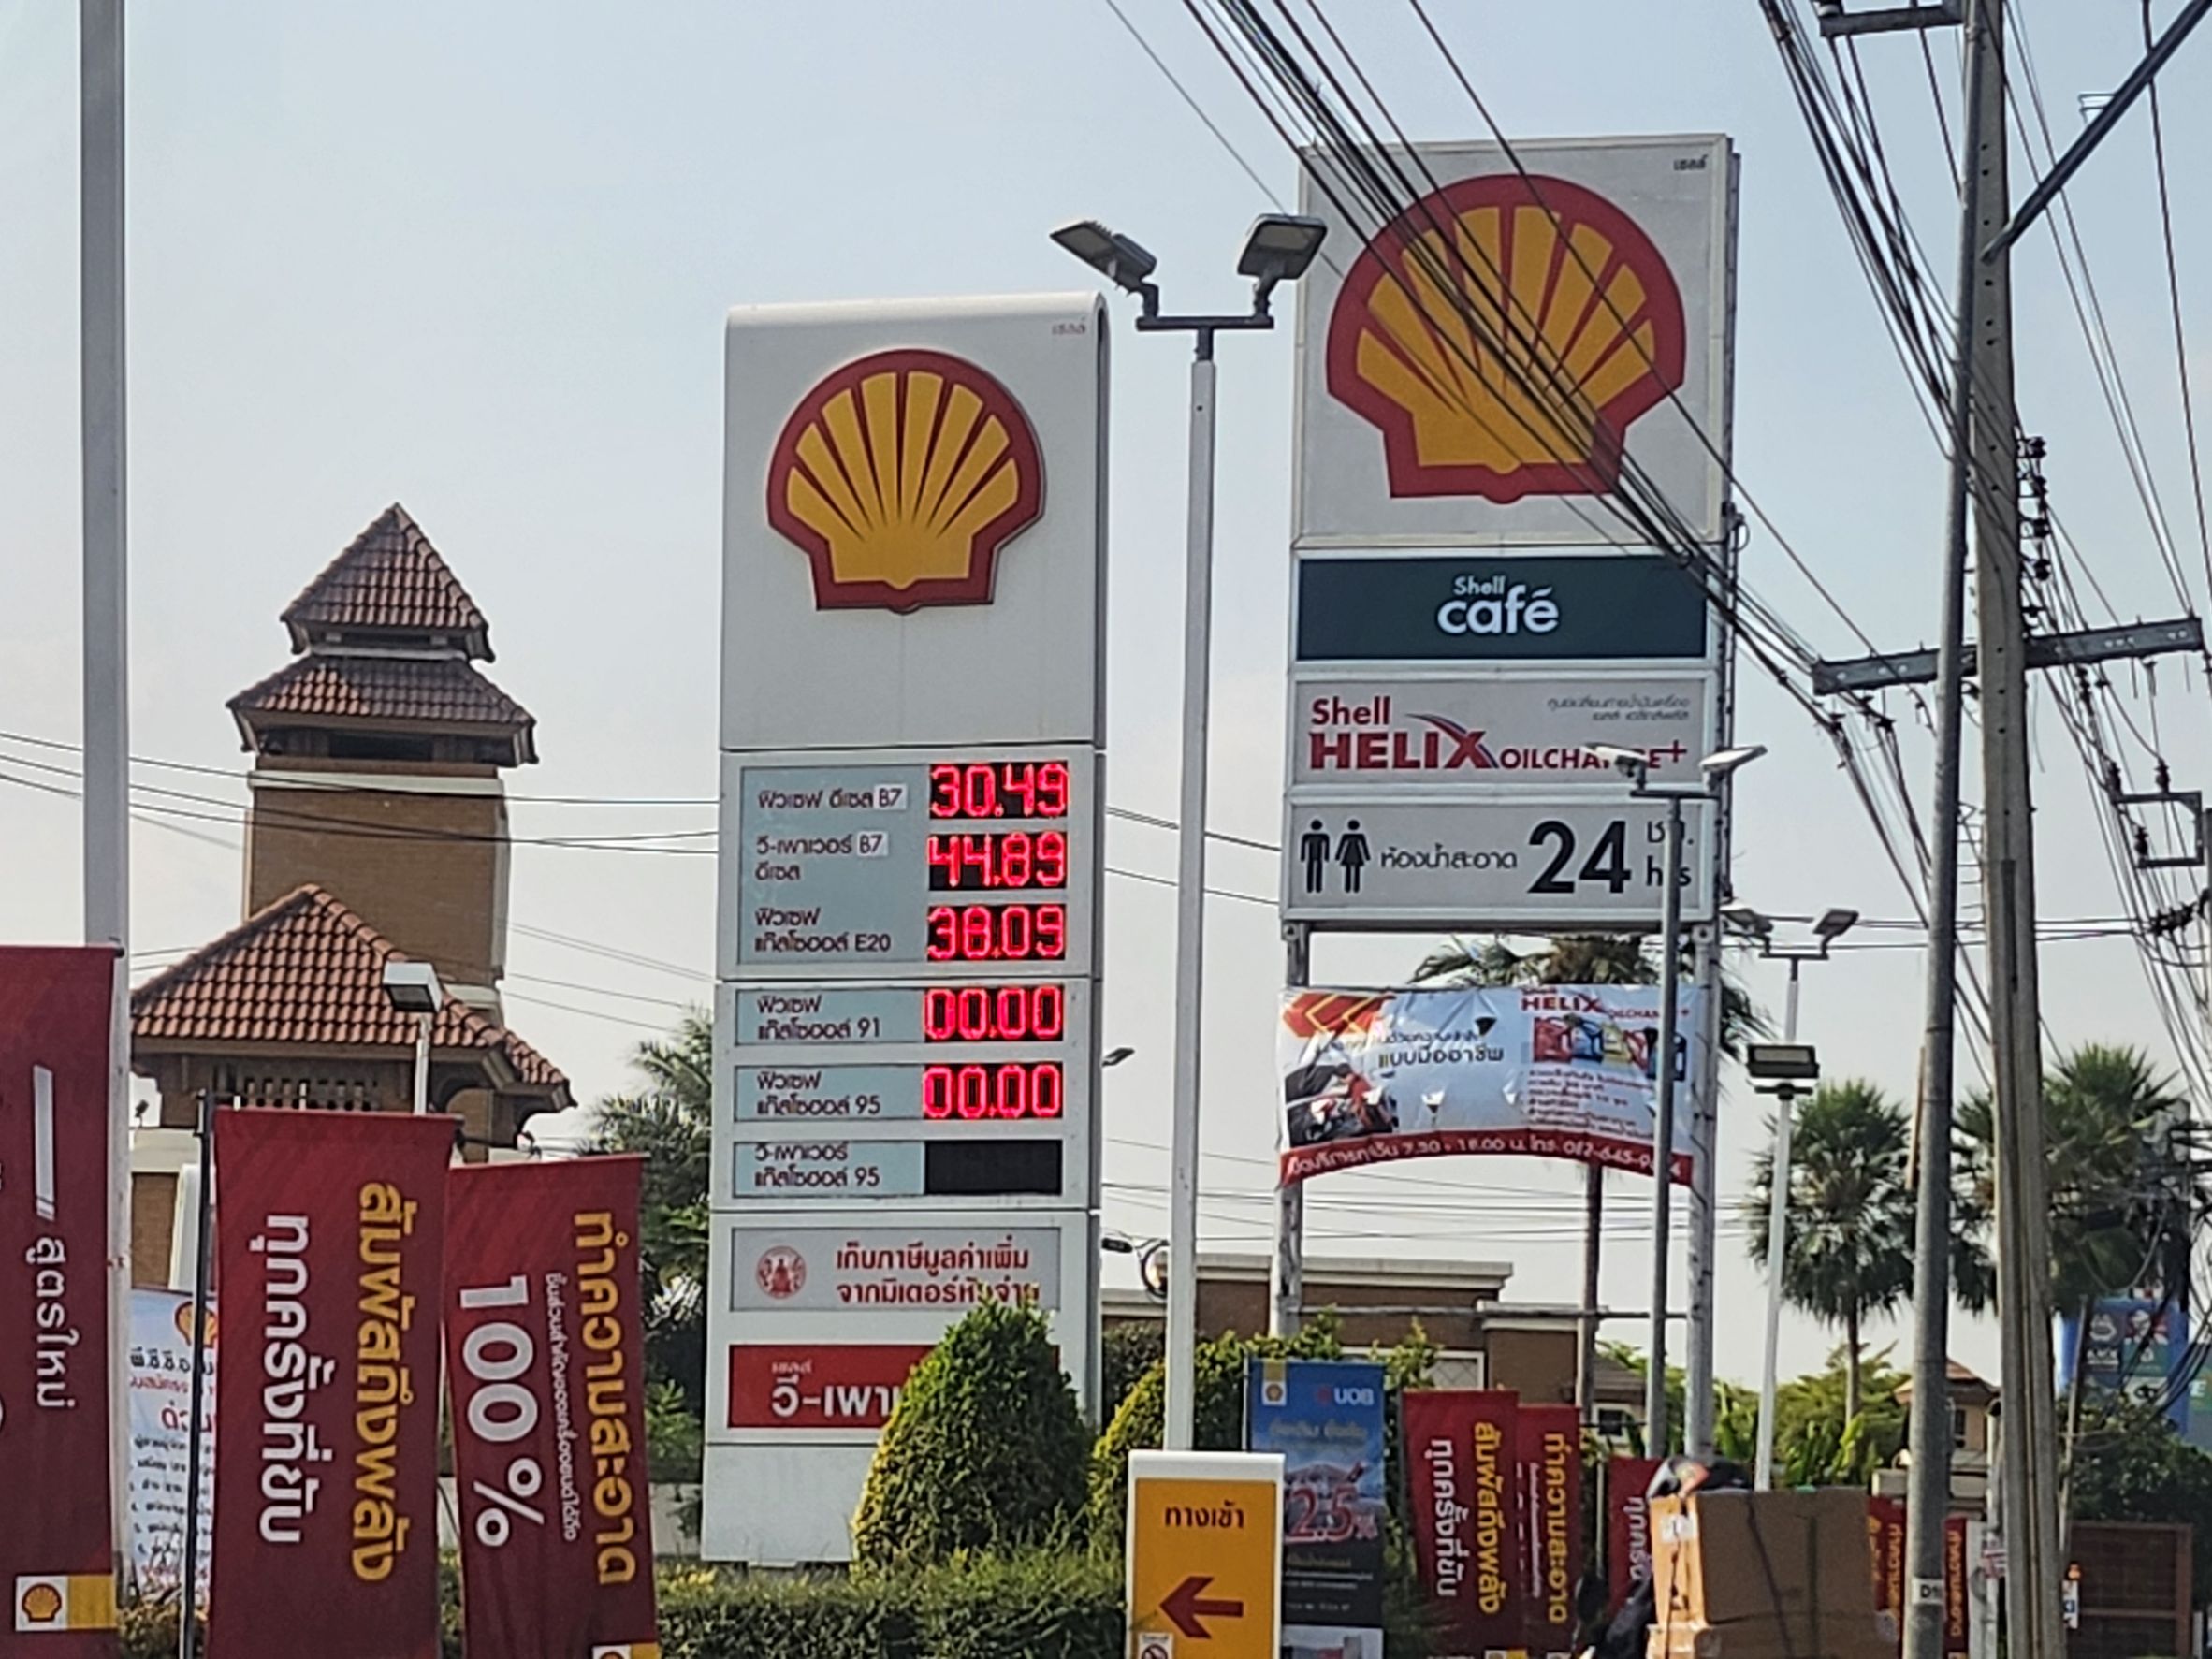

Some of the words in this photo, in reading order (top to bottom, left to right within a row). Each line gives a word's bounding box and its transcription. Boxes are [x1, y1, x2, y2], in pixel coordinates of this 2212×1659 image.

[1436, 585, 1560, 634] café
[1453, 575, 1506, 595] Shell
[1310, 695, 1391, 726] Shell
[1309, 719, 1497, 769] HELIX
[878, 787, 903, 808] B7
[930, 763, 1069, 818] 30.49
[858, 834, 883, 854] B7
[926, 830, 1066, 887] 44.89
[1380, 841, 1519, 870] ห้องน้ำสะอาด
[1527, 819, 1632, 895] 24
[1646, 854, 1693, 888] hs
[854, 933, 892, 953] E20
[927, 905, 1065, 960] 38.09
[857, 1017, 881, 1038] 91
[924, 984, 1062, 1041] 00.00
[1521, 993, 1608, 1013] HELIX
[855, 1094, 881, 1115] 95
[923, 1063, 1061, 1120] 00.00
[854, 1165, 880, 1187] 95
[837, 1234, 1029, 1278] เก็บภาษีมูลค่าเพิ่ม
[25, 1236, 76, 1410] สูตรใหม่
[249, 1215, 336, 1543] ทุกครั้งที่ขับ
[350, 1181, 418, 1582] สัมผัสถึงพลัง
[574, 1211, 638, 1585] ทำความสะอาด
[1333, 1387, 1375, 1405] UOB
[1164, 1500, 1245, 1529] ทางเข้า
[1424, 1438, 1470, 1596] ทุกครั้งที่ขับ
[1474, 1421, 1507, 1614] สัมผัสถึงพลัง
[1544, 1433, 1573, 1623] ทำความสะอาด
